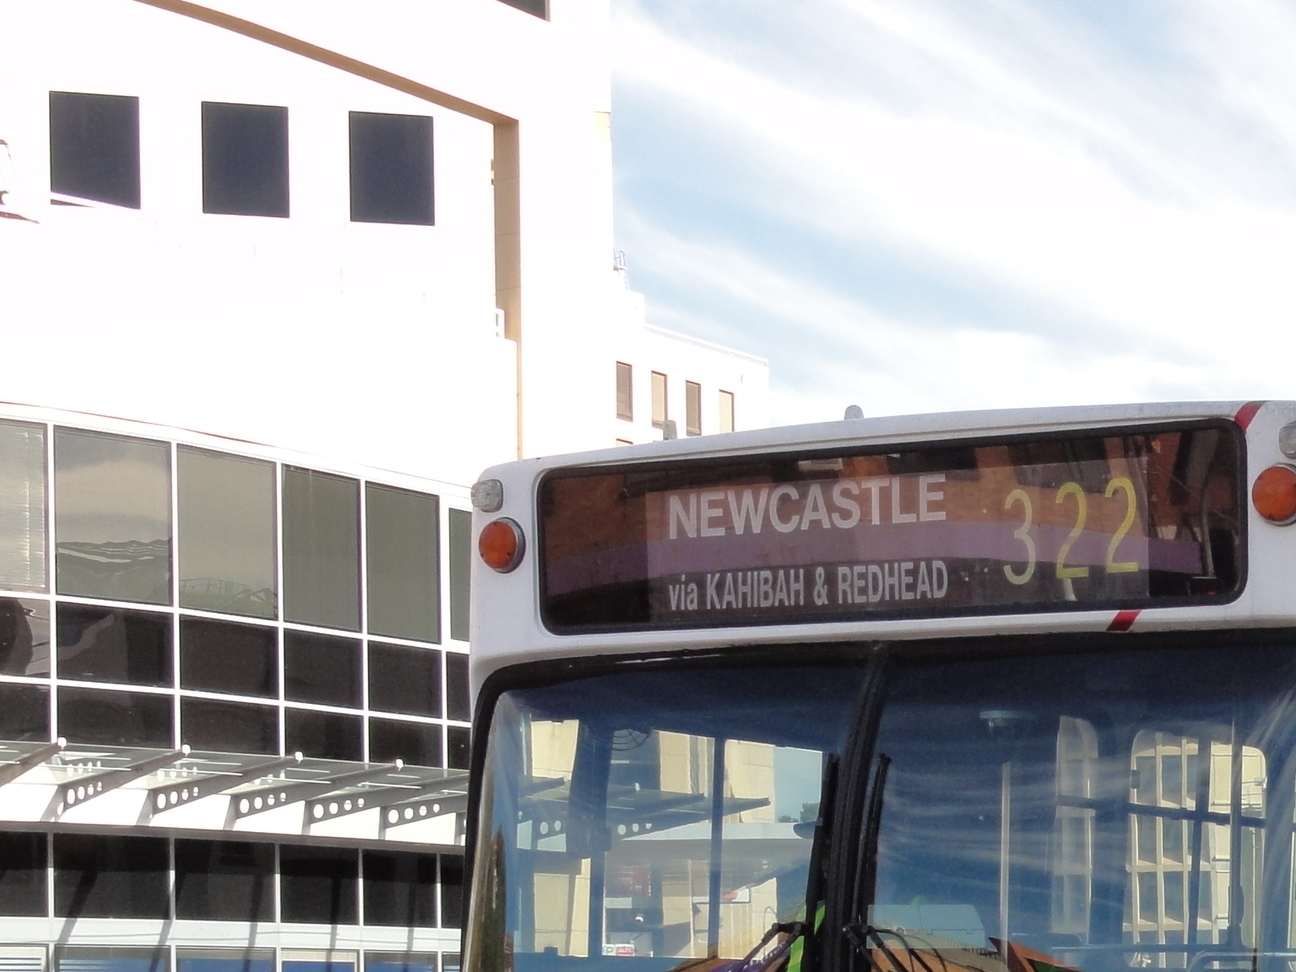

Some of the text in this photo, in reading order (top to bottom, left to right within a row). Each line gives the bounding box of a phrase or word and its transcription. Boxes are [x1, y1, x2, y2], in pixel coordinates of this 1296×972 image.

[668, 473, 947, 540] NEWCASTLE
[1003, 476, 1139, 586] 322
[669, 560, 949, 611] via KAHIBAH & REDHEAD
